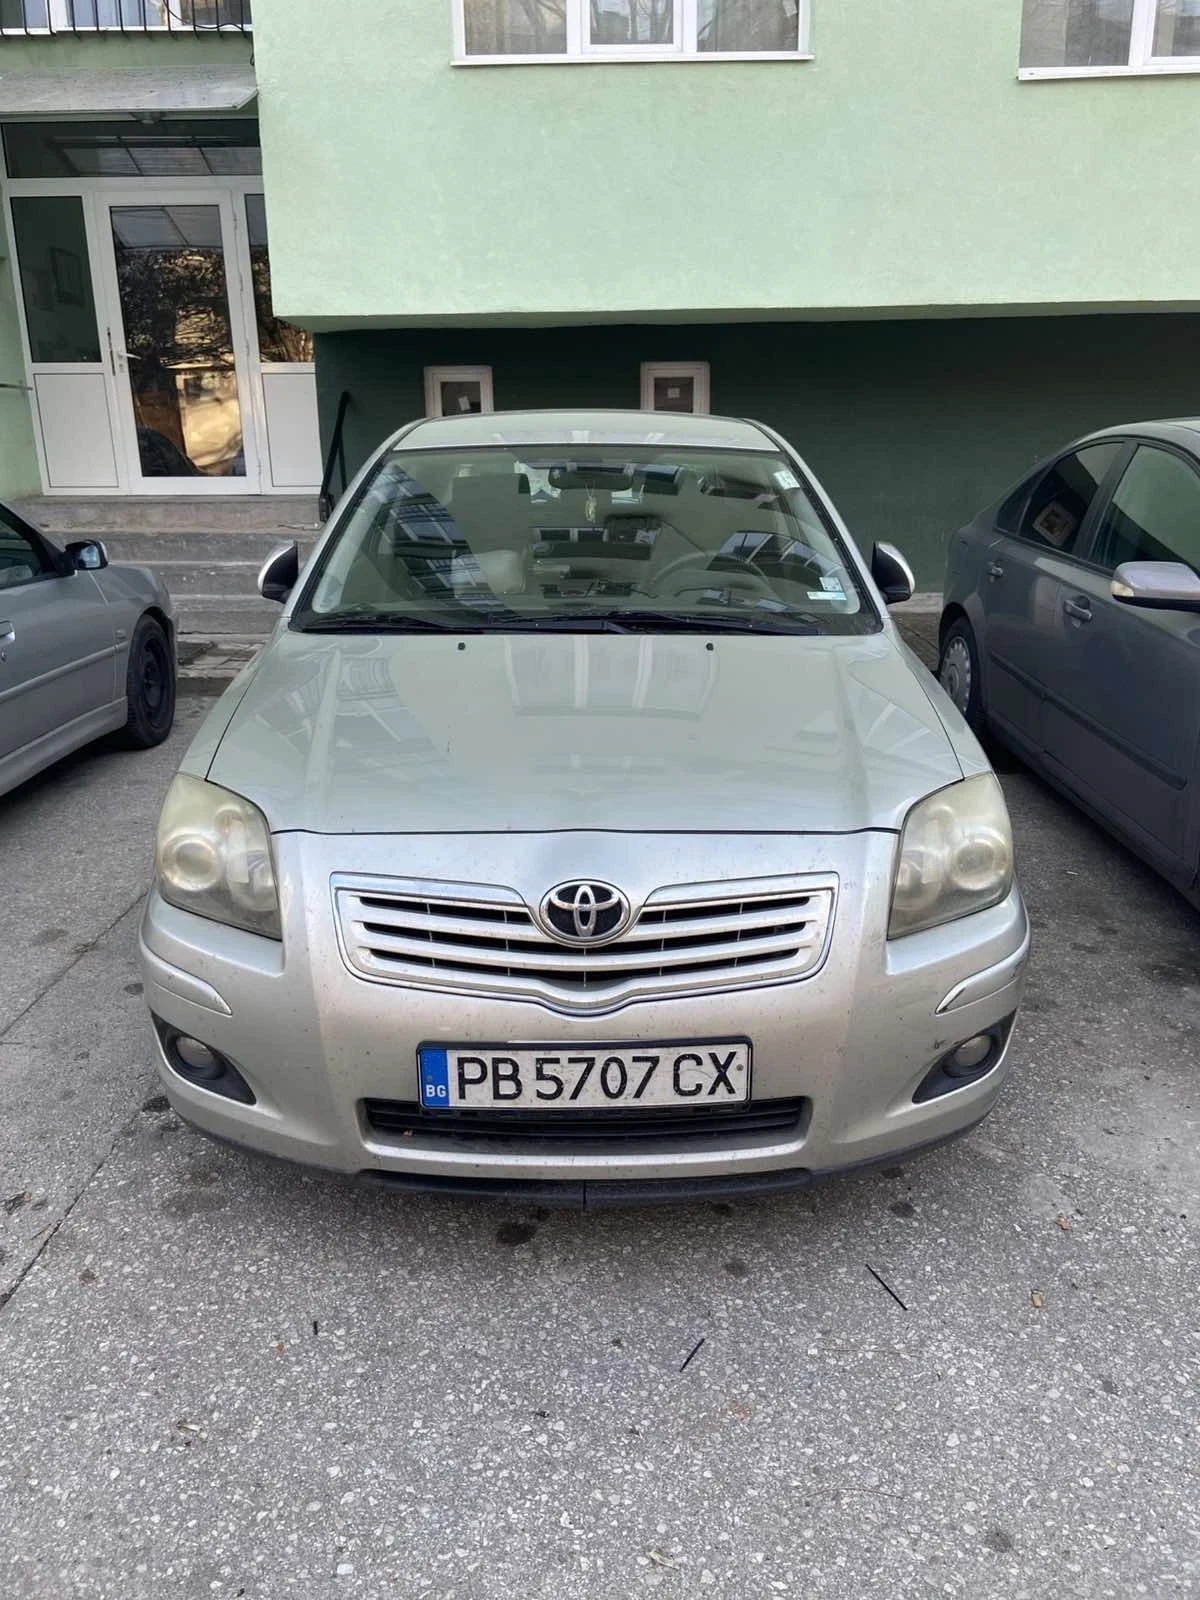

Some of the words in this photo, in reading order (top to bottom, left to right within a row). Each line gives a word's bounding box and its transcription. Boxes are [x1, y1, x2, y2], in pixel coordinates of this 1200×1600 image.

[426, 1085, 447, 1098] BG
[457, 1056, 523, 1100] PB
[535, 1055, 660, 1101] 5707
[672, 1050, 738, 1097] CX
